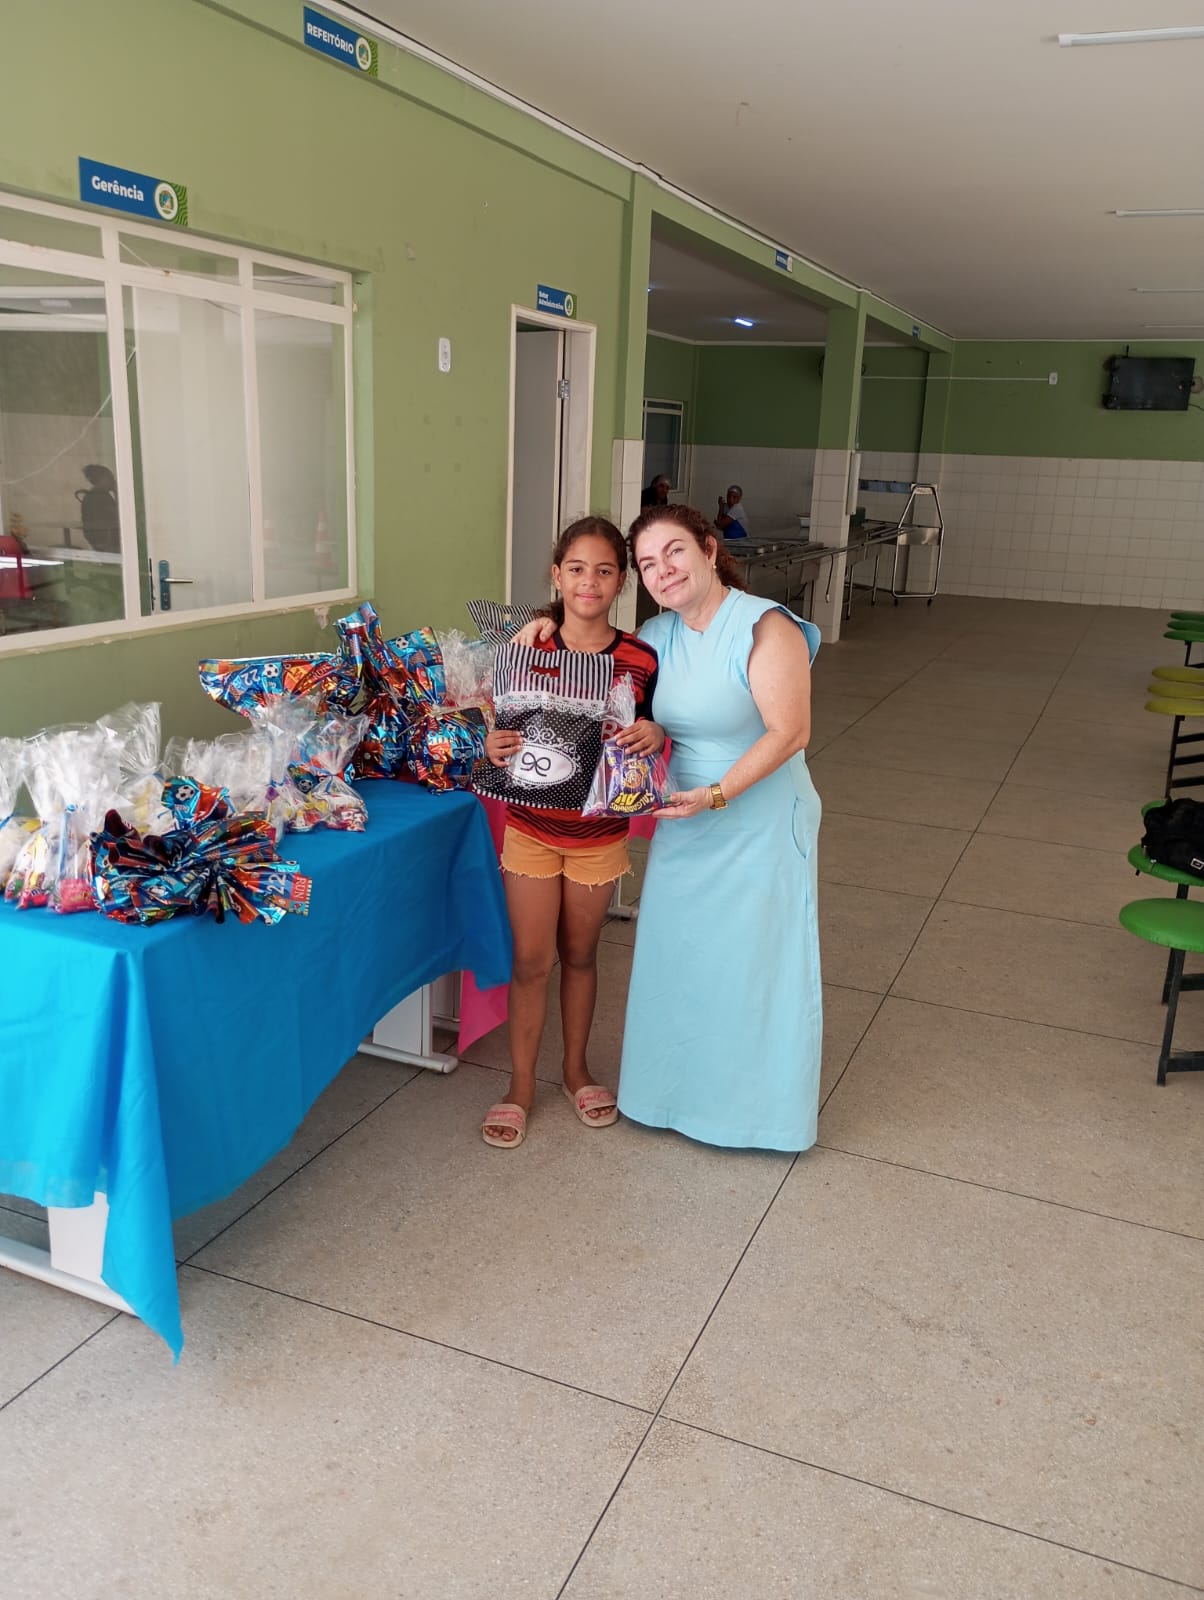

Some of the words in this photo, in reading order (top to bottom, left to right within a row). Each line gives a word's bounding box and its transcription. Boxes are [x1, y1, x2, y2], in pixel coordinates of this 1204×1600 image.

[306, 22, 355, 55] REFEITÓRIO
[91, 175, 144, 202] Gerência
[293, 876, 307, 899] RUN
